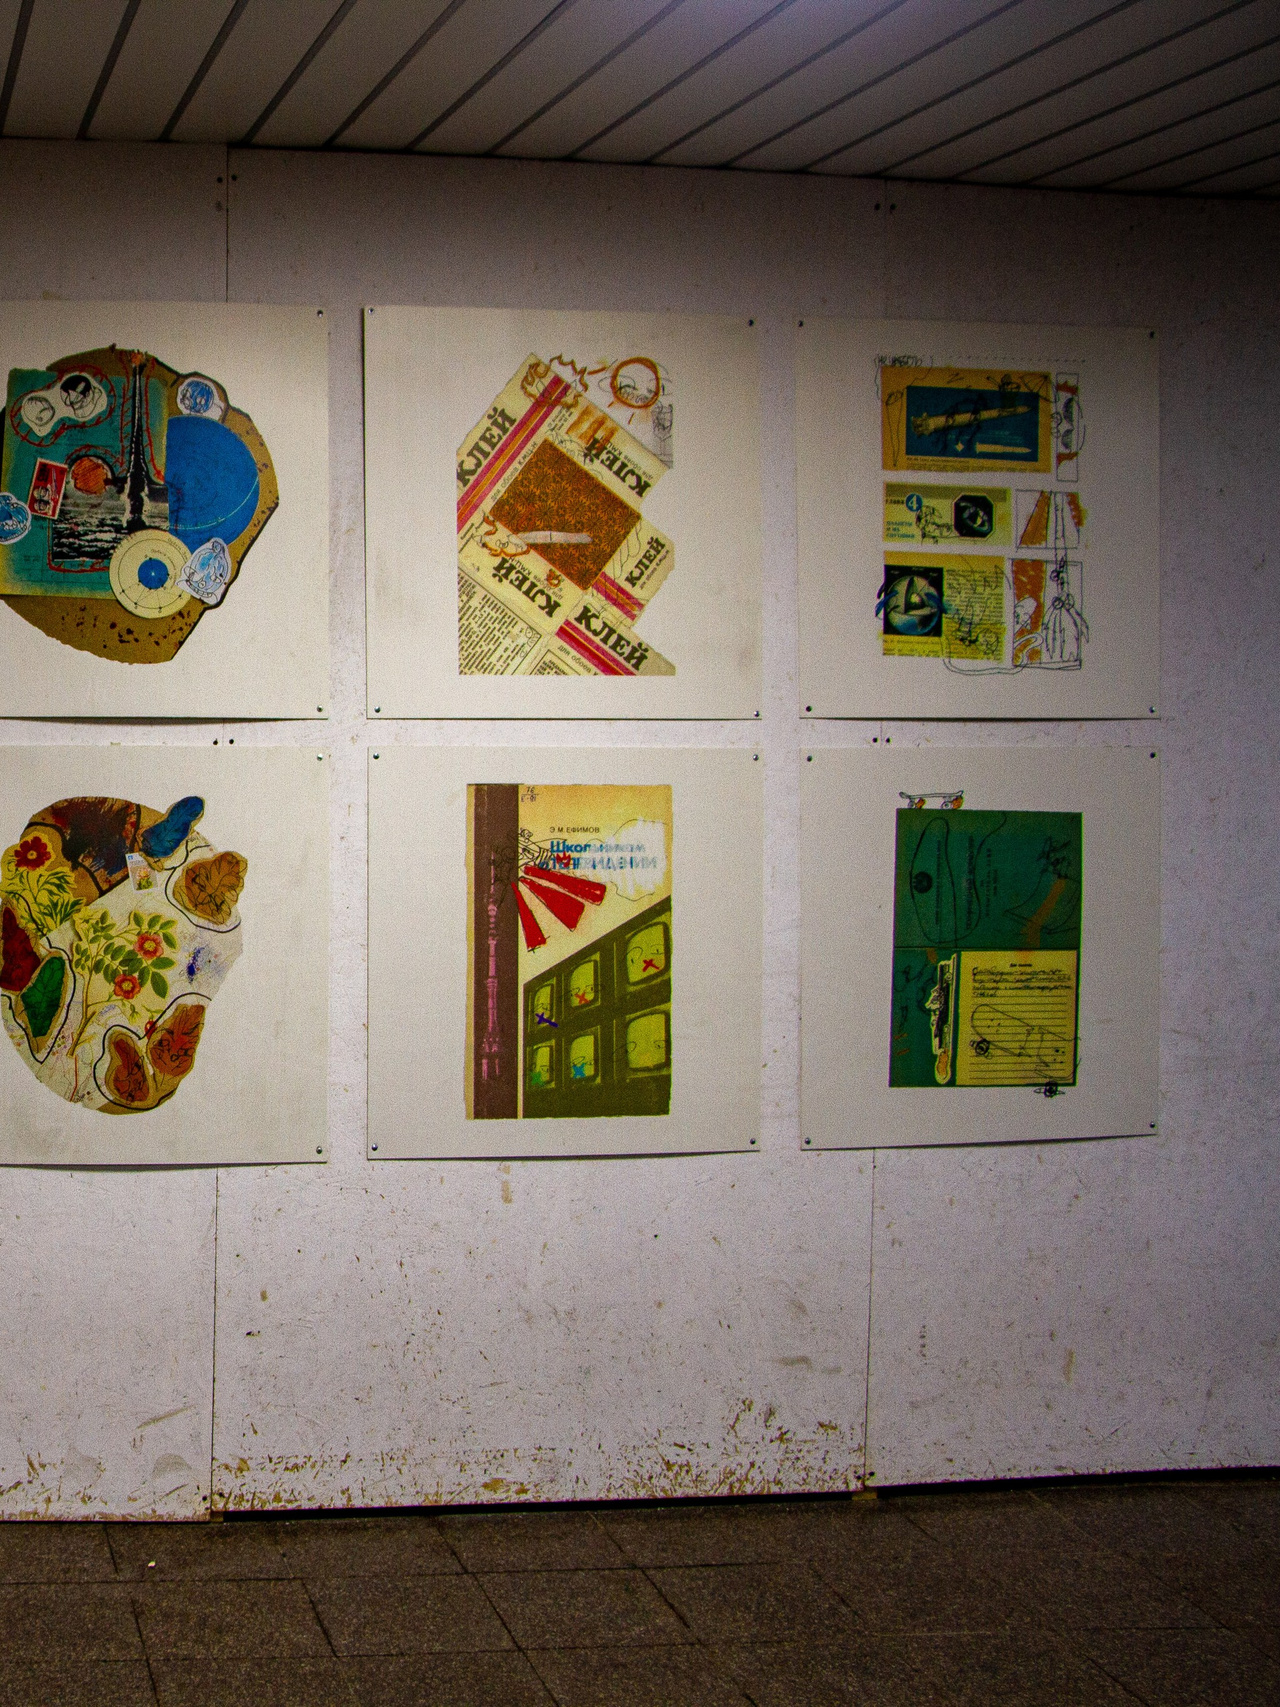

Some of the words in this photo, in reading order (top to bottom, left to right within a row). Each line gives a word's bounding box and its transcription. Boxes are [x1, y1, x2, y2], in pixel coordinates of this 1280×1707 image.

[457, 406, 517, 487] КЛЕЙ
[584, 437, 652, 498] КЛЕЙ
[908, 495, 919, 511] 4
[492, 556, 561, 618] КЛЕЙ
[625, 536, 666, 588] КЛЕЙ
[574, 605, 649, 671] КЛЕЙ
